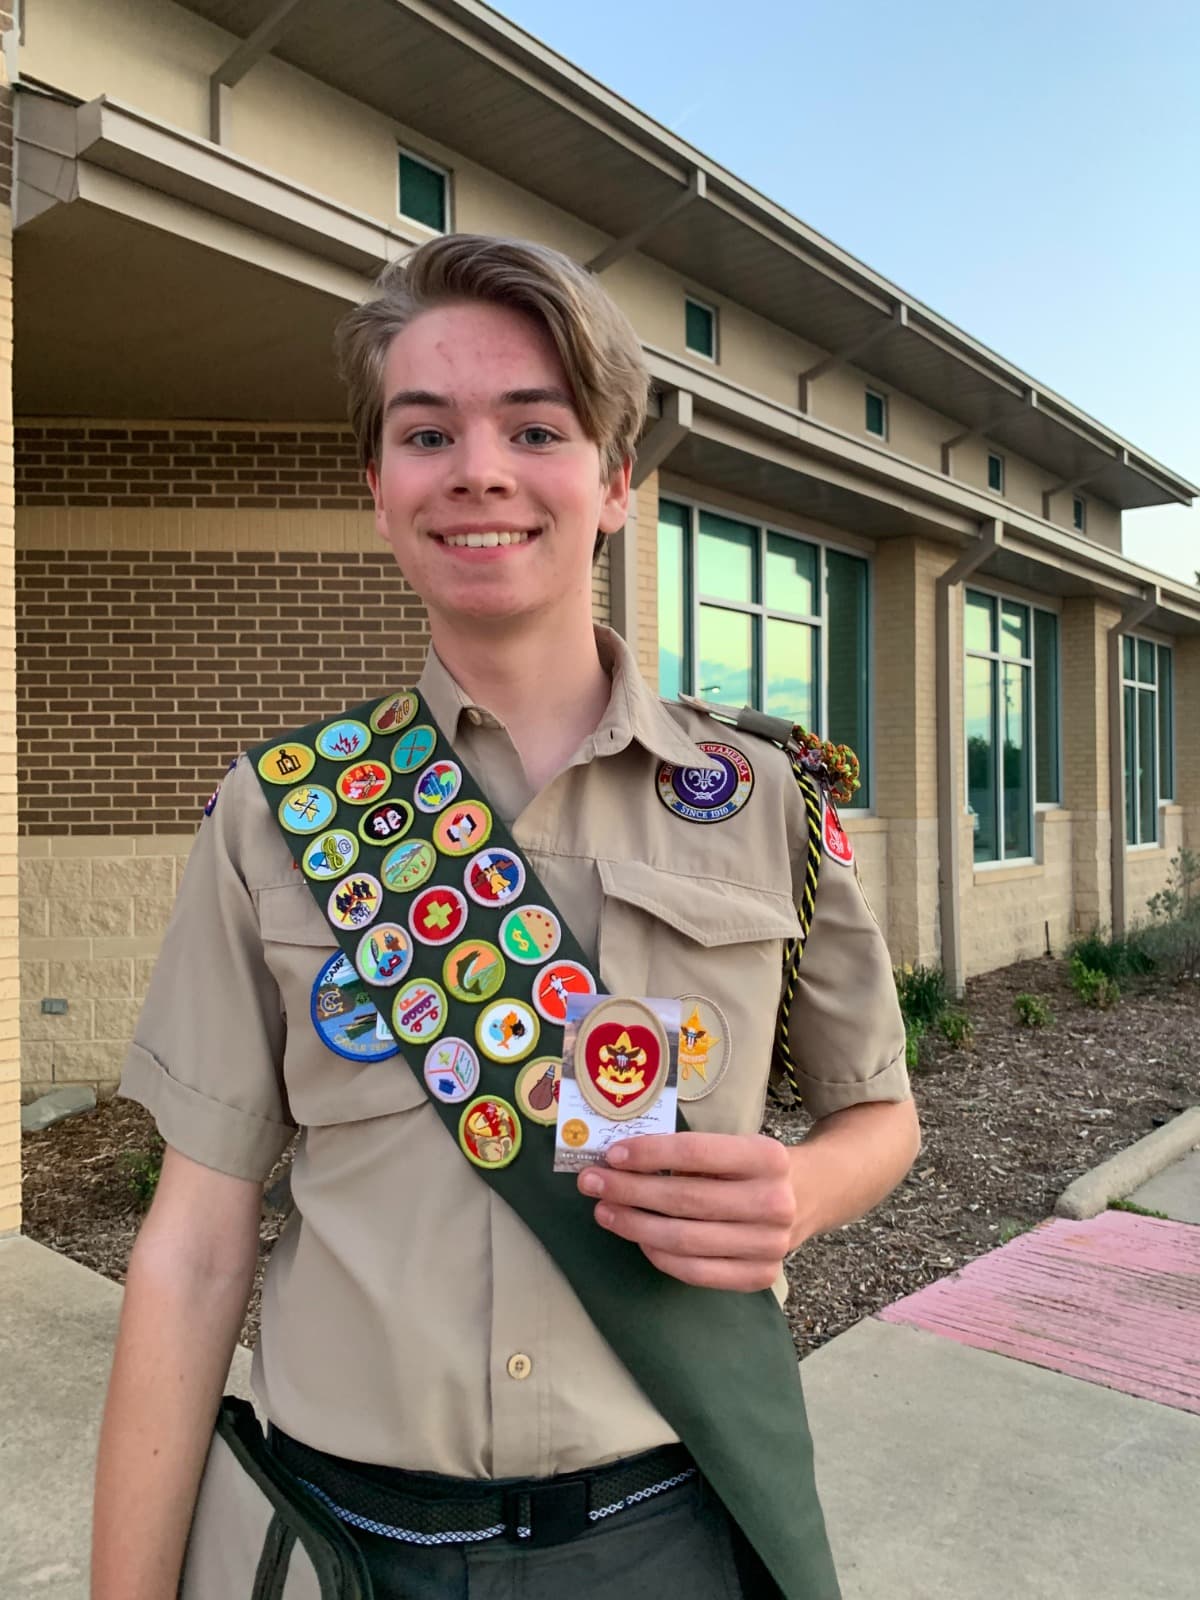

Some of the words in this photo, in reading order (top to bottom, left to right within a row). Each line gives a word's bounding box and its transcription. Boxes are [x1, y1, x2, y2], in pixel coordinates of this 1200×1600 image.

[718, 746, 748, 776] AMERICA
[344, 765, 373, 783] SAR
[680, 806, 708, 819] SINCE
[711, 807, 729, 818] 1910
[325, 958, 345, 983] CAMP
